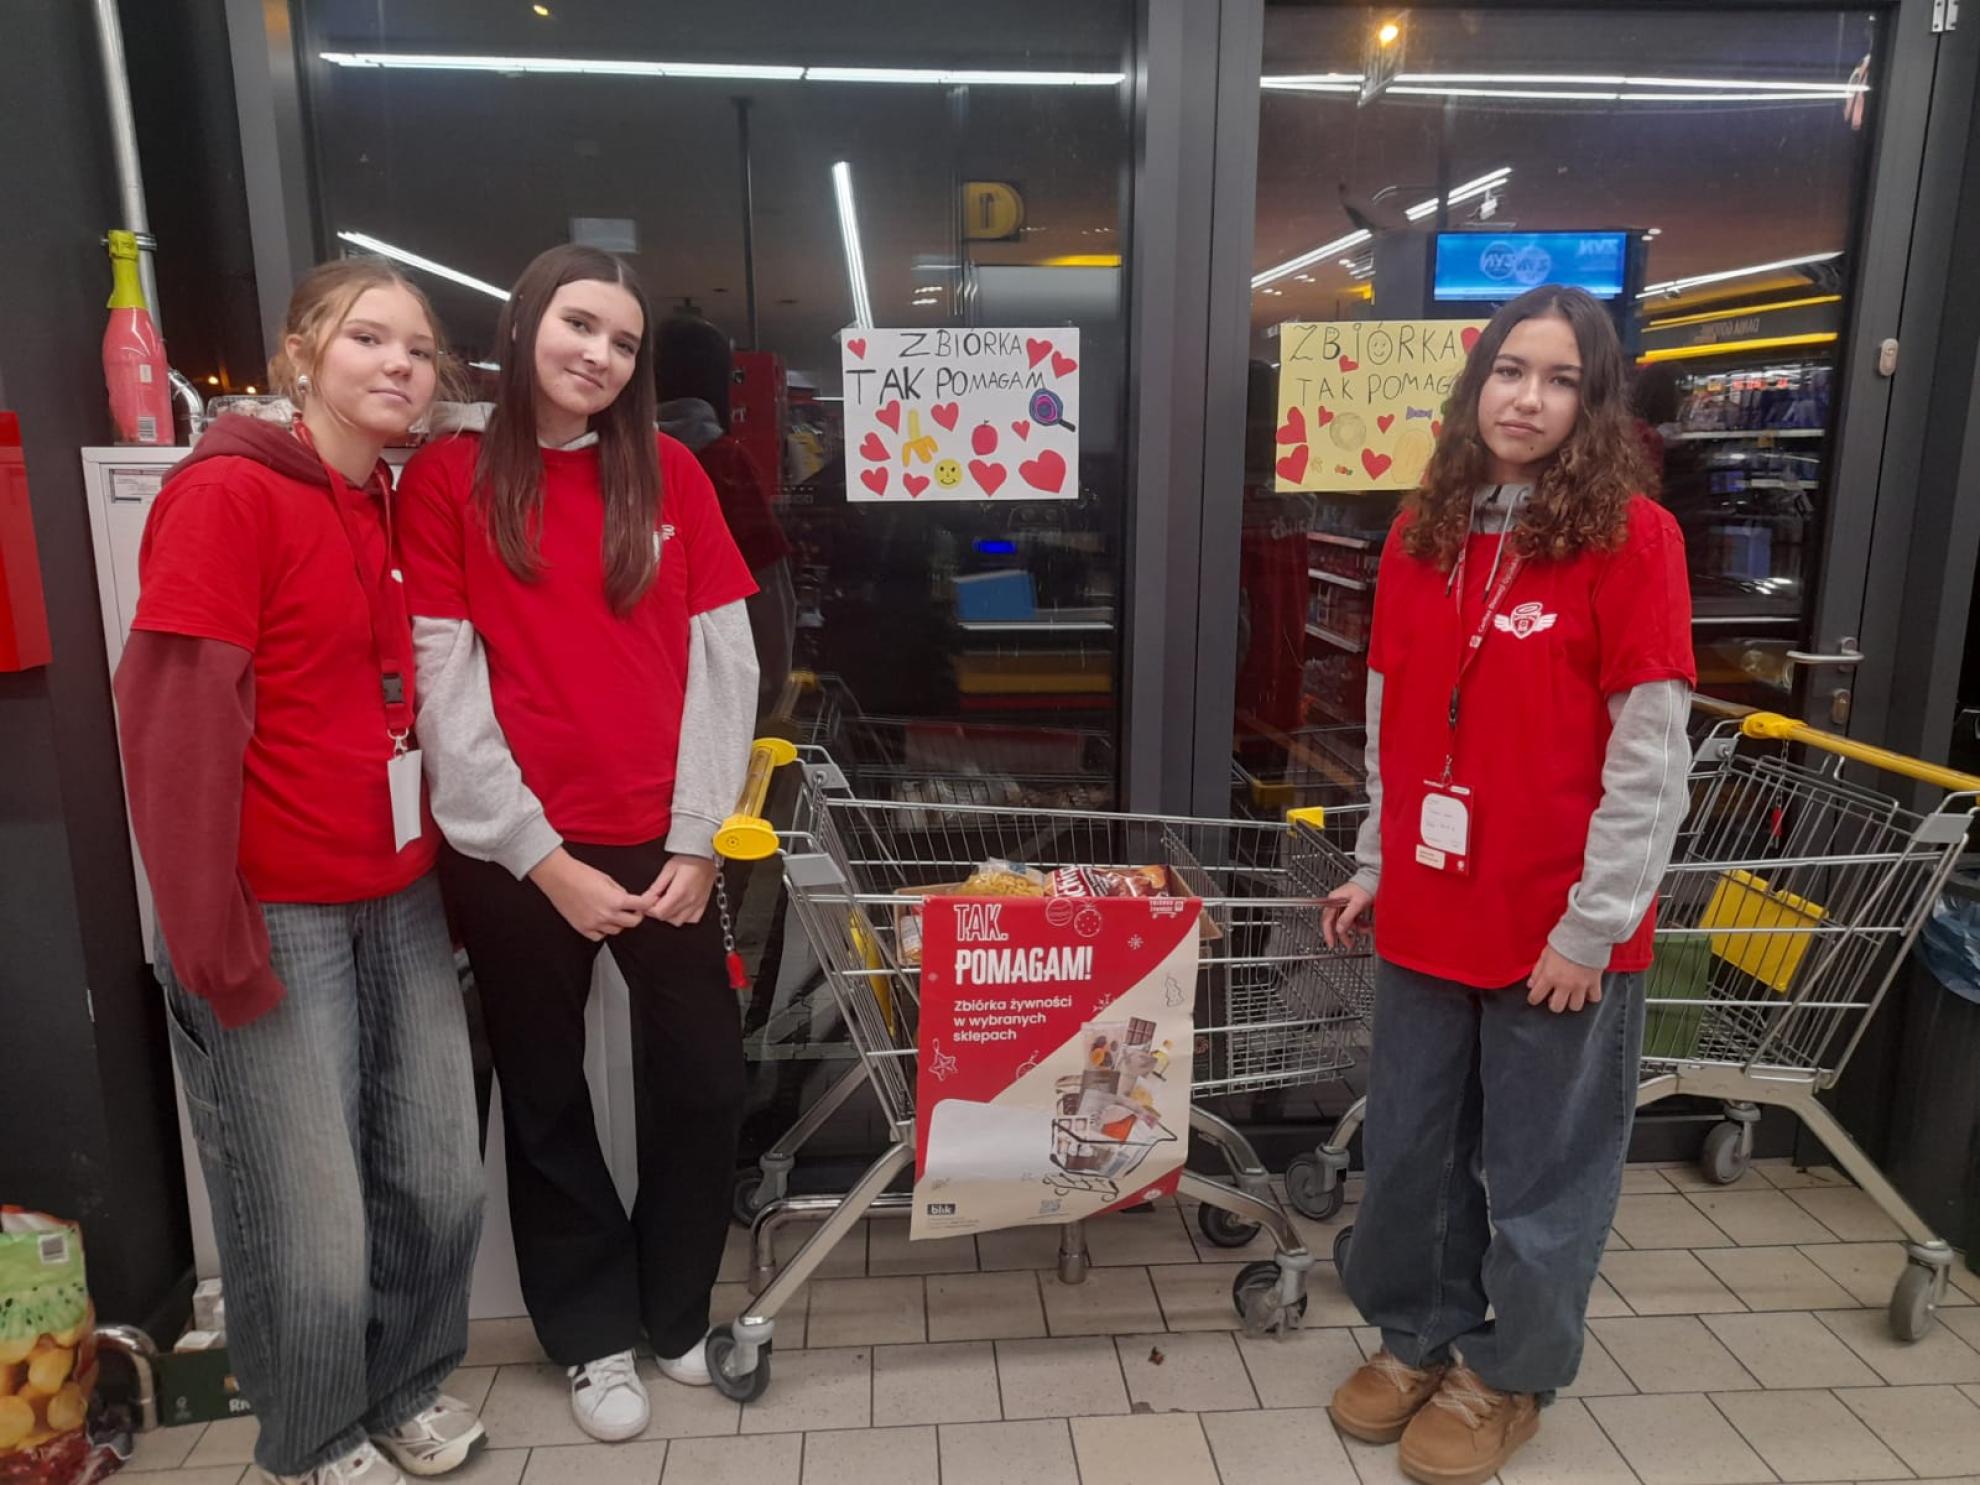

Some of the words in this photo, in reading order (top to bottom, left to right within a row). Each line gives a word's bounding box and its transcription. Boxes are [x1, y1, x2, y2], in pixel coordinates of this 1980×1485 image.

[846, 366, 926, 405] TAK
[936, 367, 1046, 399] POMAGAM
[1297, 376, 1354, 406] TAK
[1368, 373, 1451, 404] POMAG
[953, 903, 1009, 942] TAK.
[954, 945, 1093, 985] POMAGAM!
[954, 999, 1007, 1012] Zbiórka
[1010, 994, 1072, 1012] żywności
[953, 1017, 965, 1027] w
[969, 1012, 1046, 1029] wybranych
[953, 1029, 1017, 1044] sklepach
